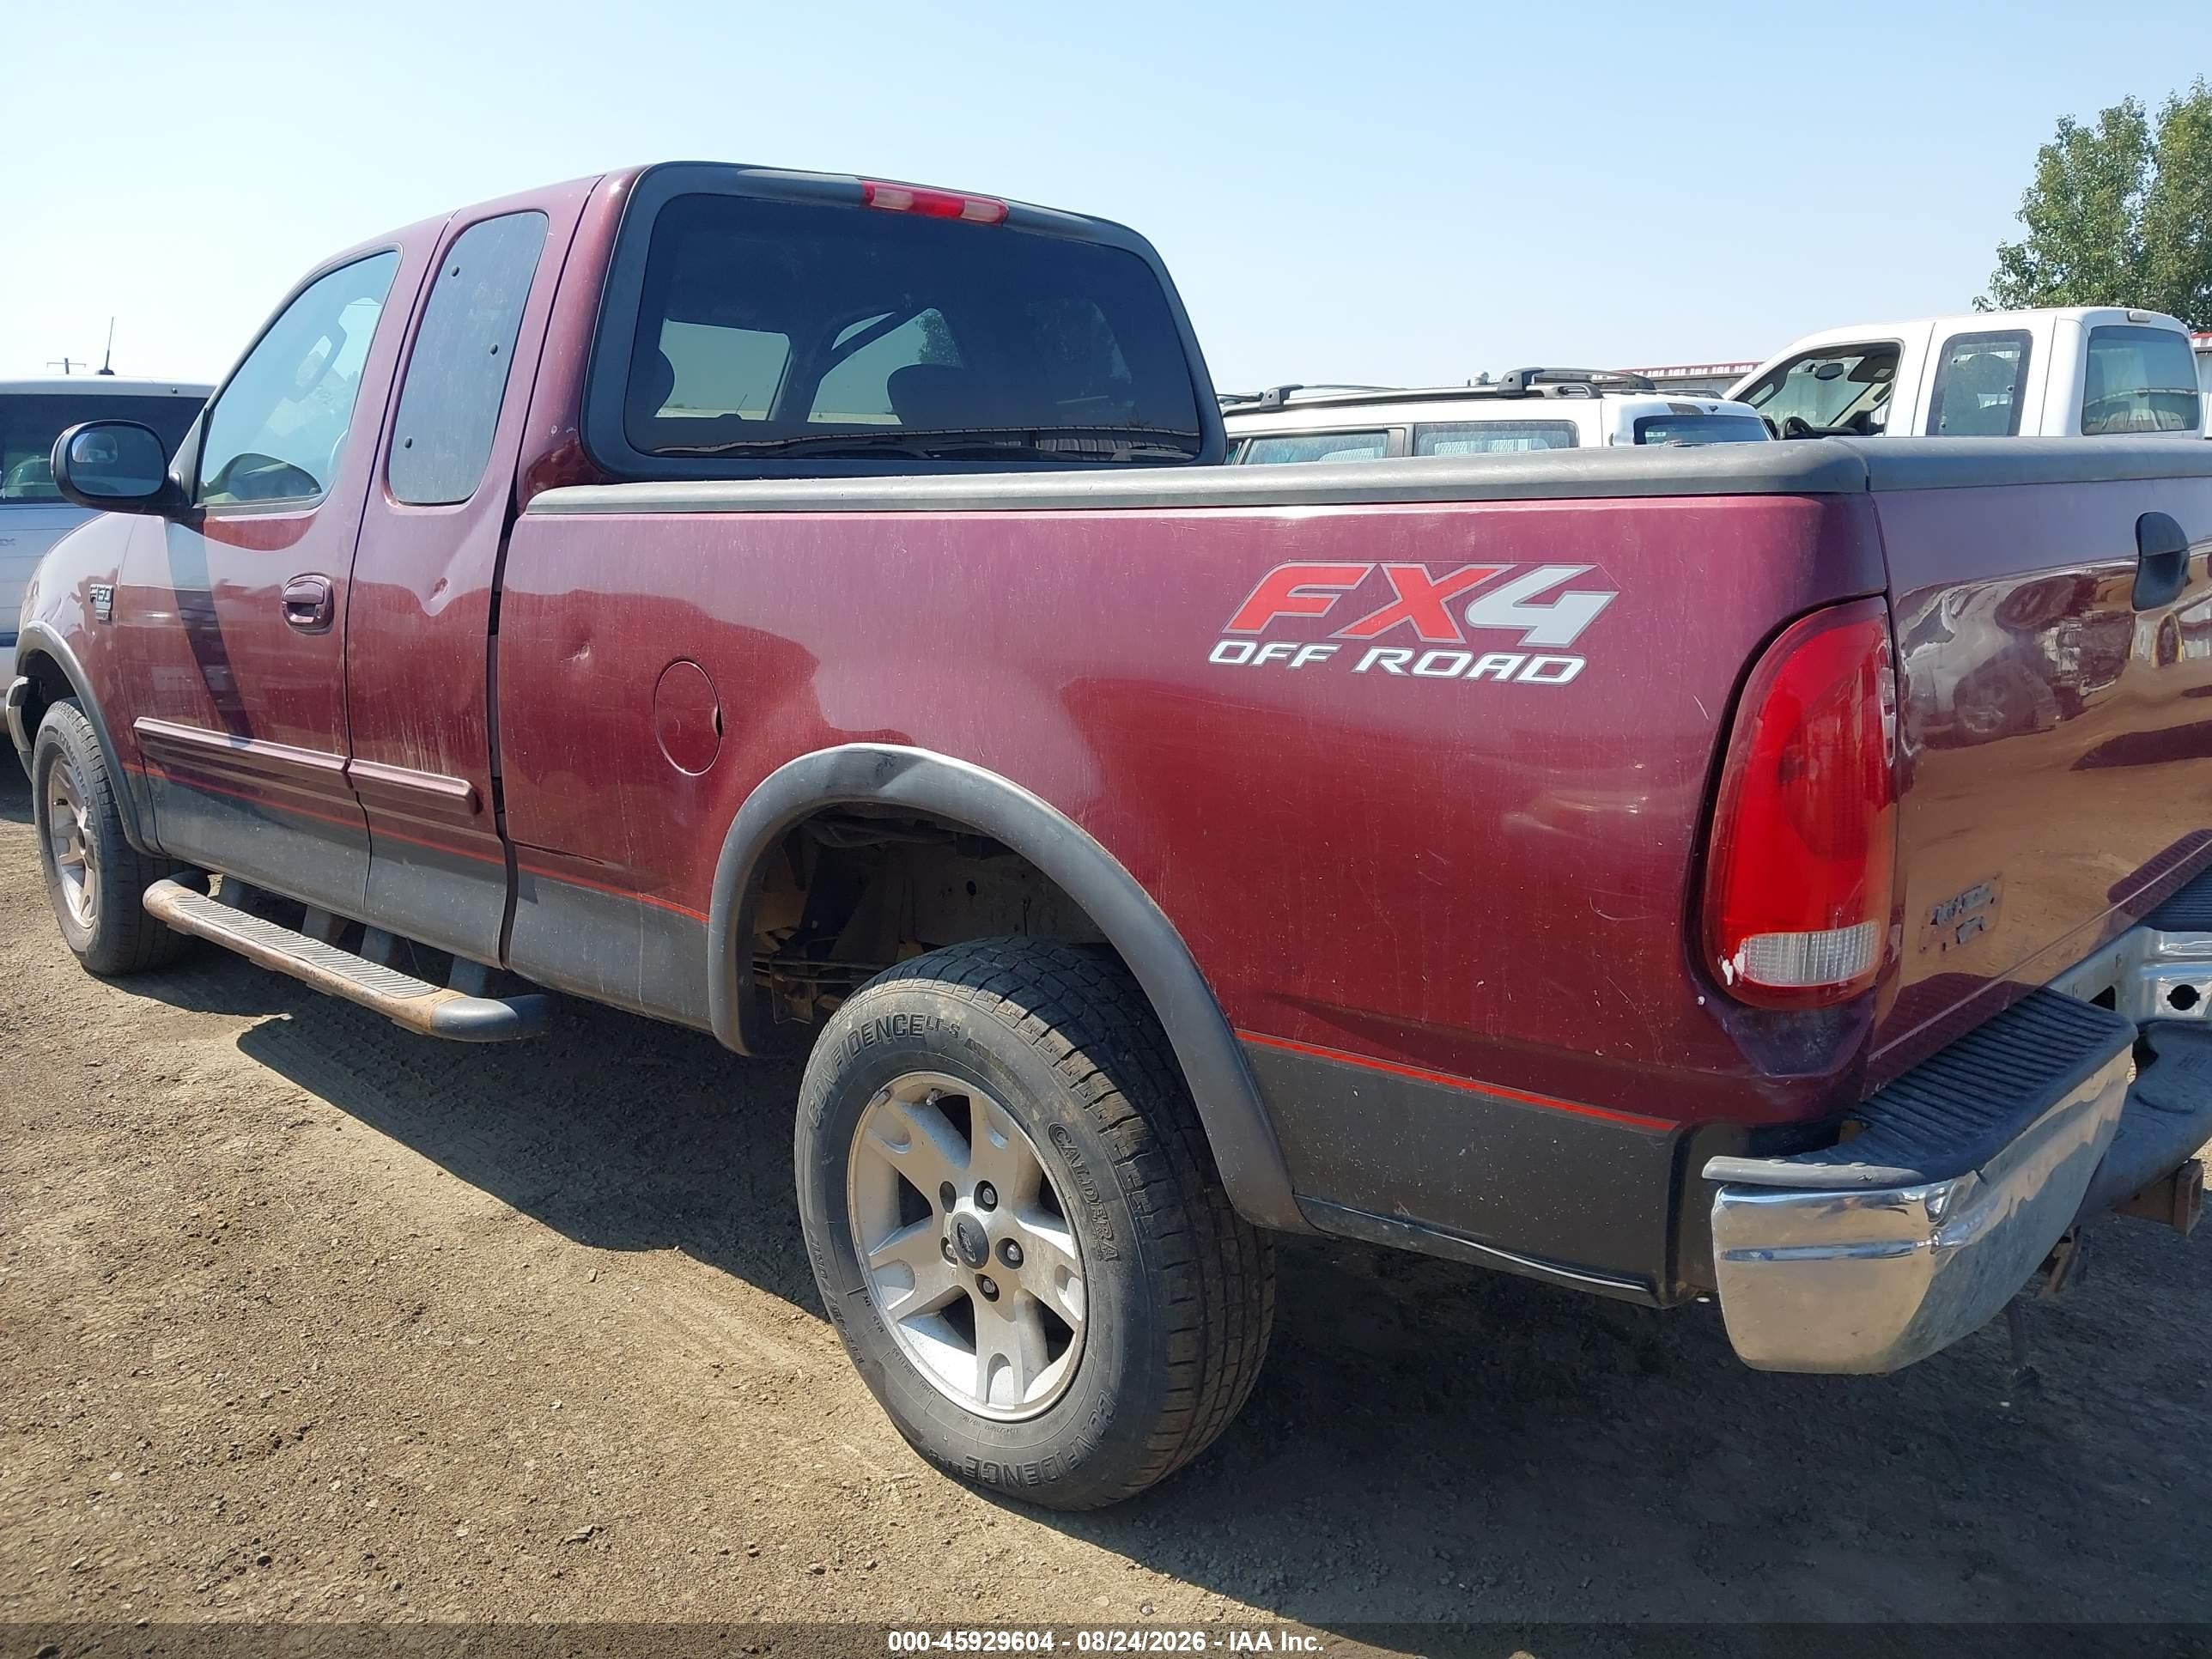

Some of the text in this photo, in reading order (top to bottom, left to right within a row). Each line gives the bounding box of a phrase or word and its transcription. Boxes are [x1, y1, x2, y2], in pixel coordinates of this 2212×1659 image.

[1222, 563, 1620, 647] FX4
[1207, 639, 1587, 684] OFF ROAD
[808, 1012, 927, 1127] CONFIDENCE
[1048, 1121, 1119, 1261] CALDERA
